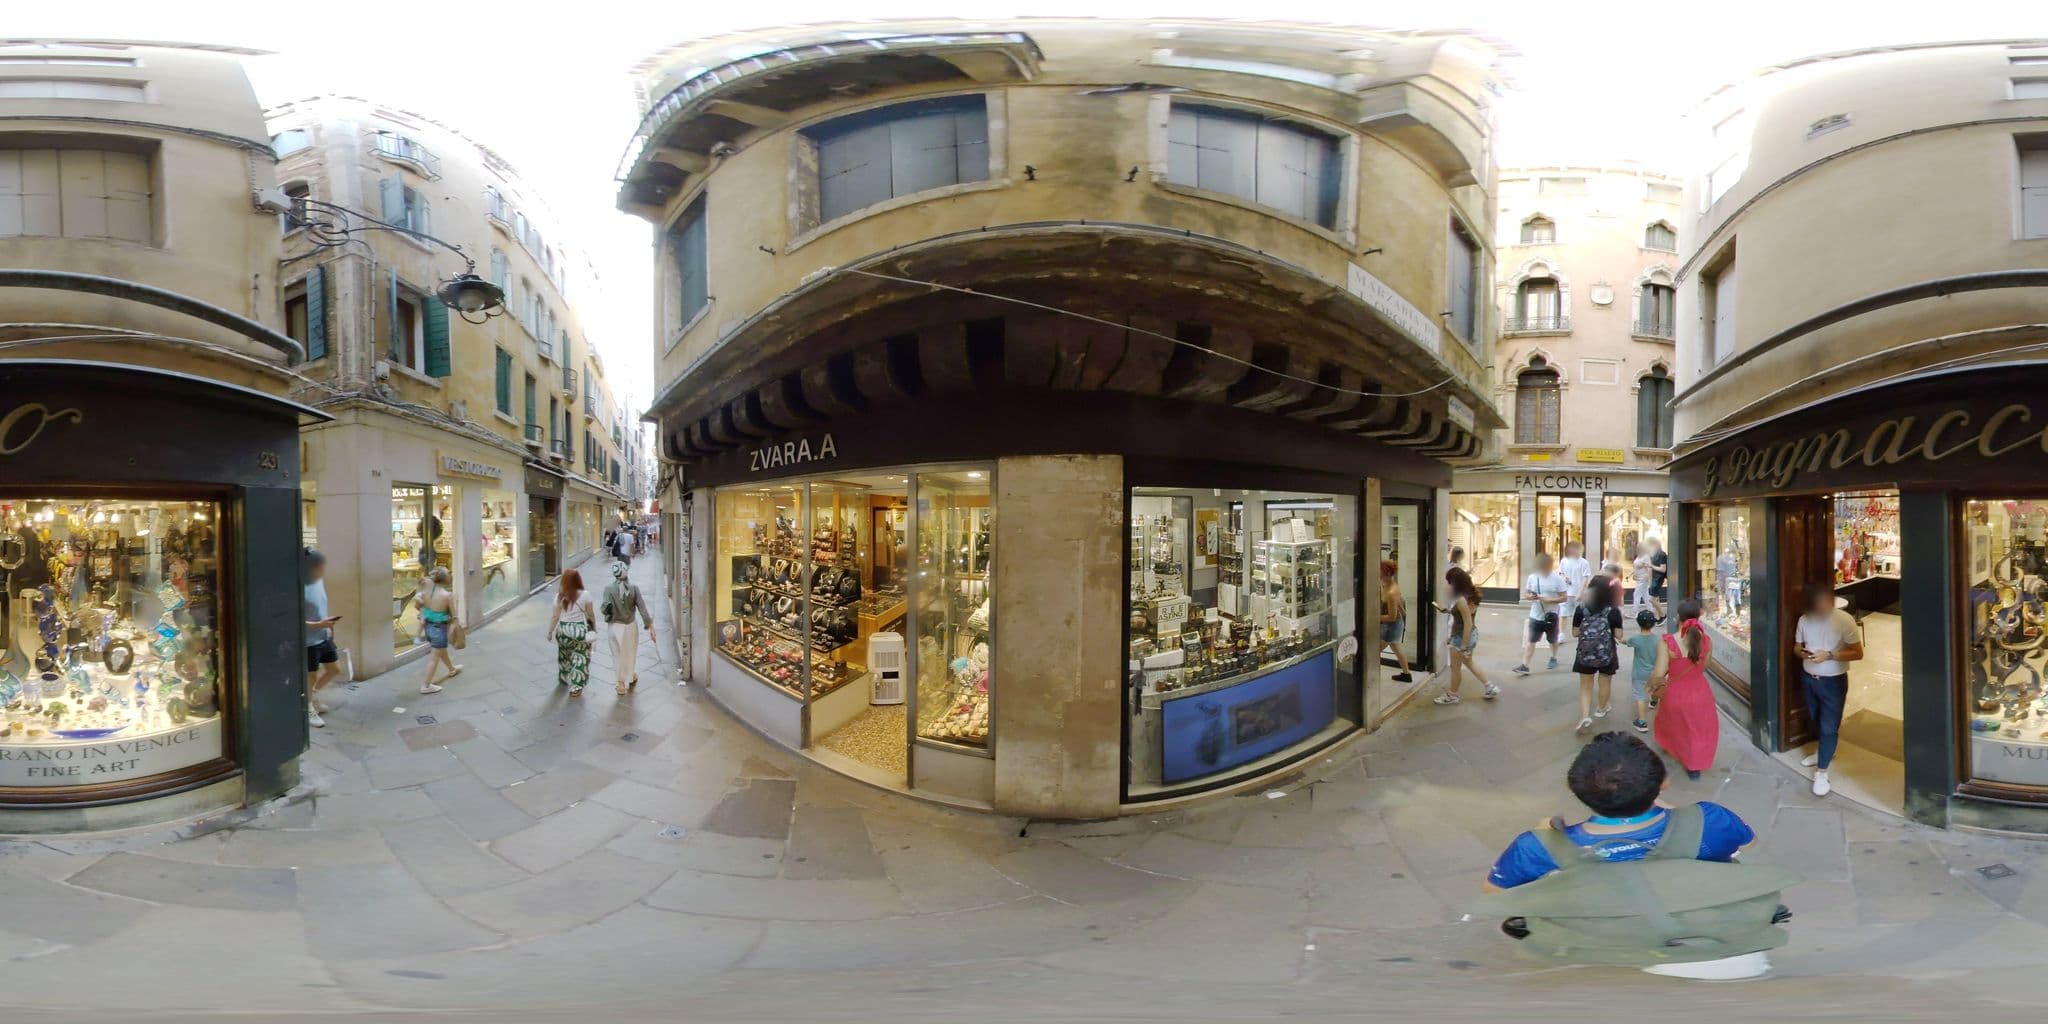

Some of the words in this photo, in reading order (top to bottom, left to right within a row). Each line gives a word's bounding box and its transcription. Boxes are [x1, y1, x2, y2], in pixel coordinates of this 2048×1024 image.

[750, 433, 837, 471] ZVARA.A
[1727, 404, 2048, 488] Pagnacc
[1515, 475, 1608, 490] FALCONERI
[1159, 612, 1184, 621] ASTING
[83, 747, 106, 759] IN
[117, 728, 201, 755] VENICE
[2001, 745, 2048, 760] MU
[27, 765, 80, 777] FINE
[91, 758, 141, 775] ART
